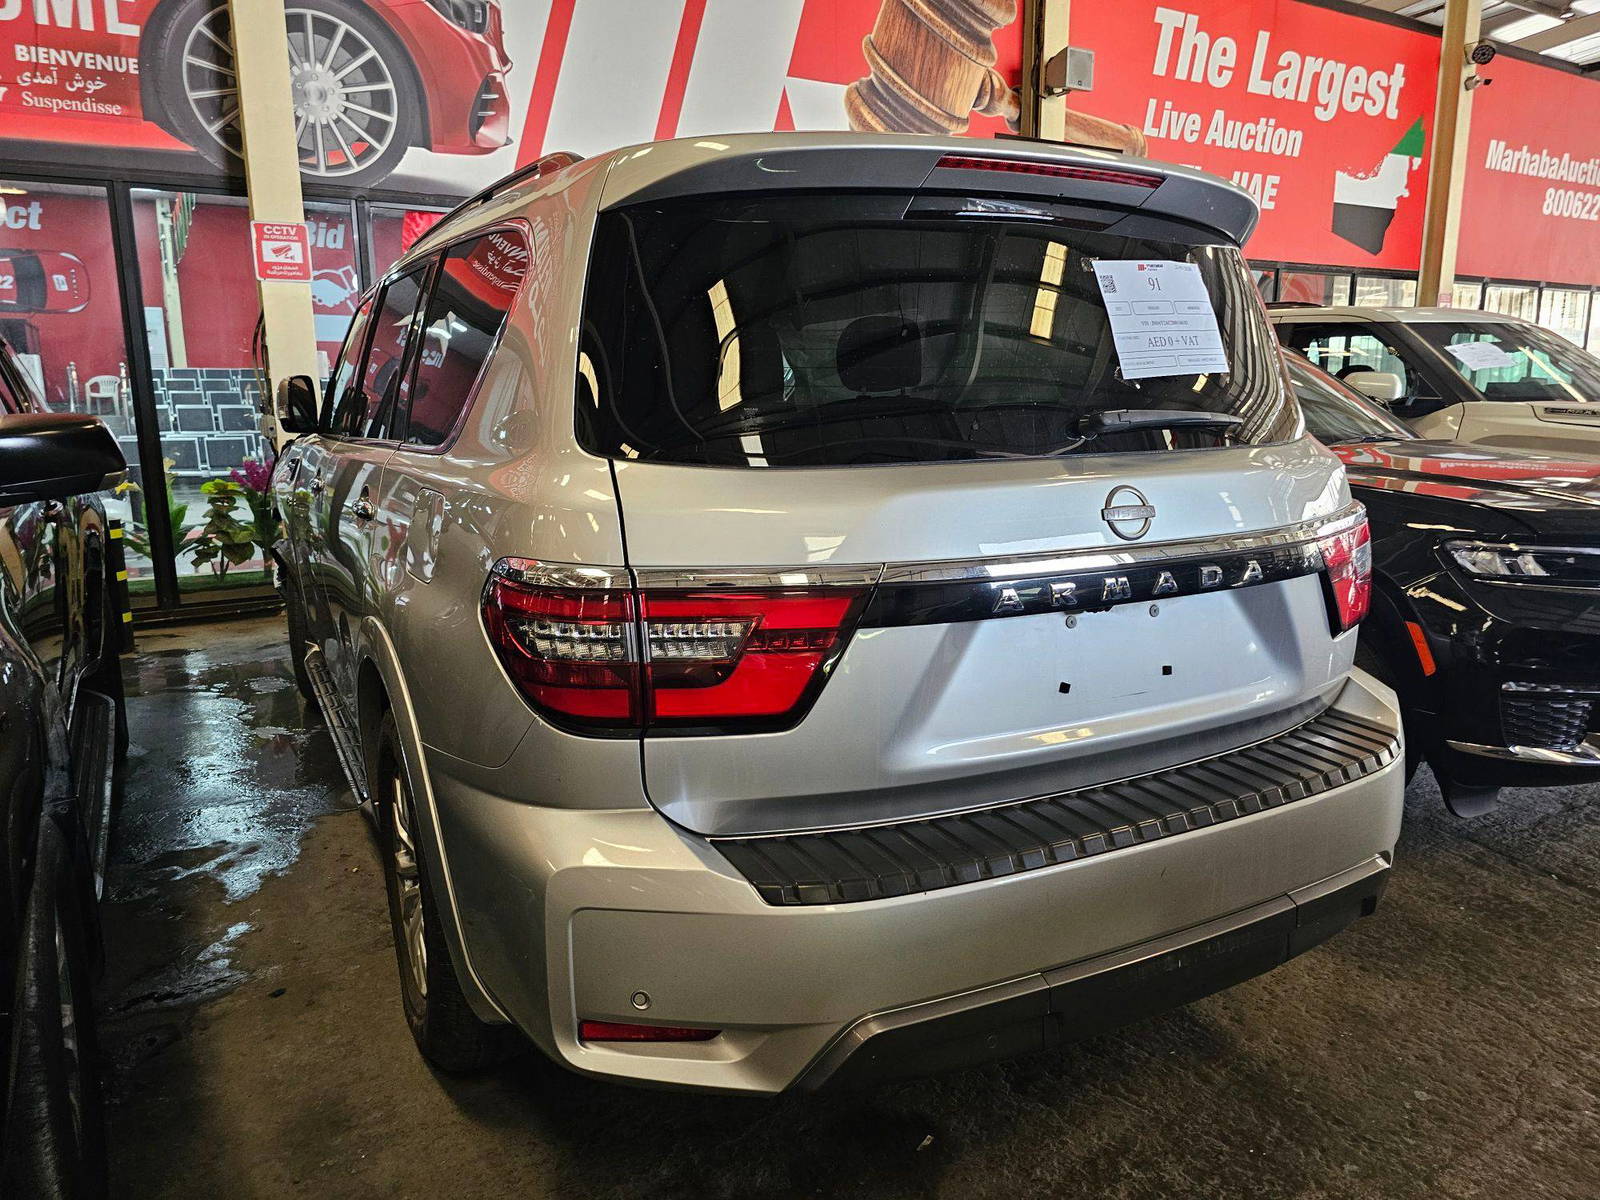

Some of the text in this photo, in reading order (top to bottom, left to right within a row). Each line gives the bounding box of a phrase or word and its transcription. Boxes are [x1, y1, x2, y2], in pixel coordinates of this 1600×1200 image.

[15, 44, 139, 75] BIENVENUE
[1152, 6, 1405, 122] The Largest
[21, 90, 122, 116] Suspendisse
[1143, 98, 1304, 158] Live Auction
[1485, 139, 1600, 187] MarhabaAucti
[5, 201, 43, 230] ct
[1543, 187, 1600, 221] 800622
[263, 225, 297, 235] CCTV
[305, 220, 346, 249] Bid
[1147, 276, 1161, 291] 91
[1148, 336, 1167, 348] AED
[1181, 335, 1200, 346] VAT
[992, 560, 1264, 613] ARMADA
